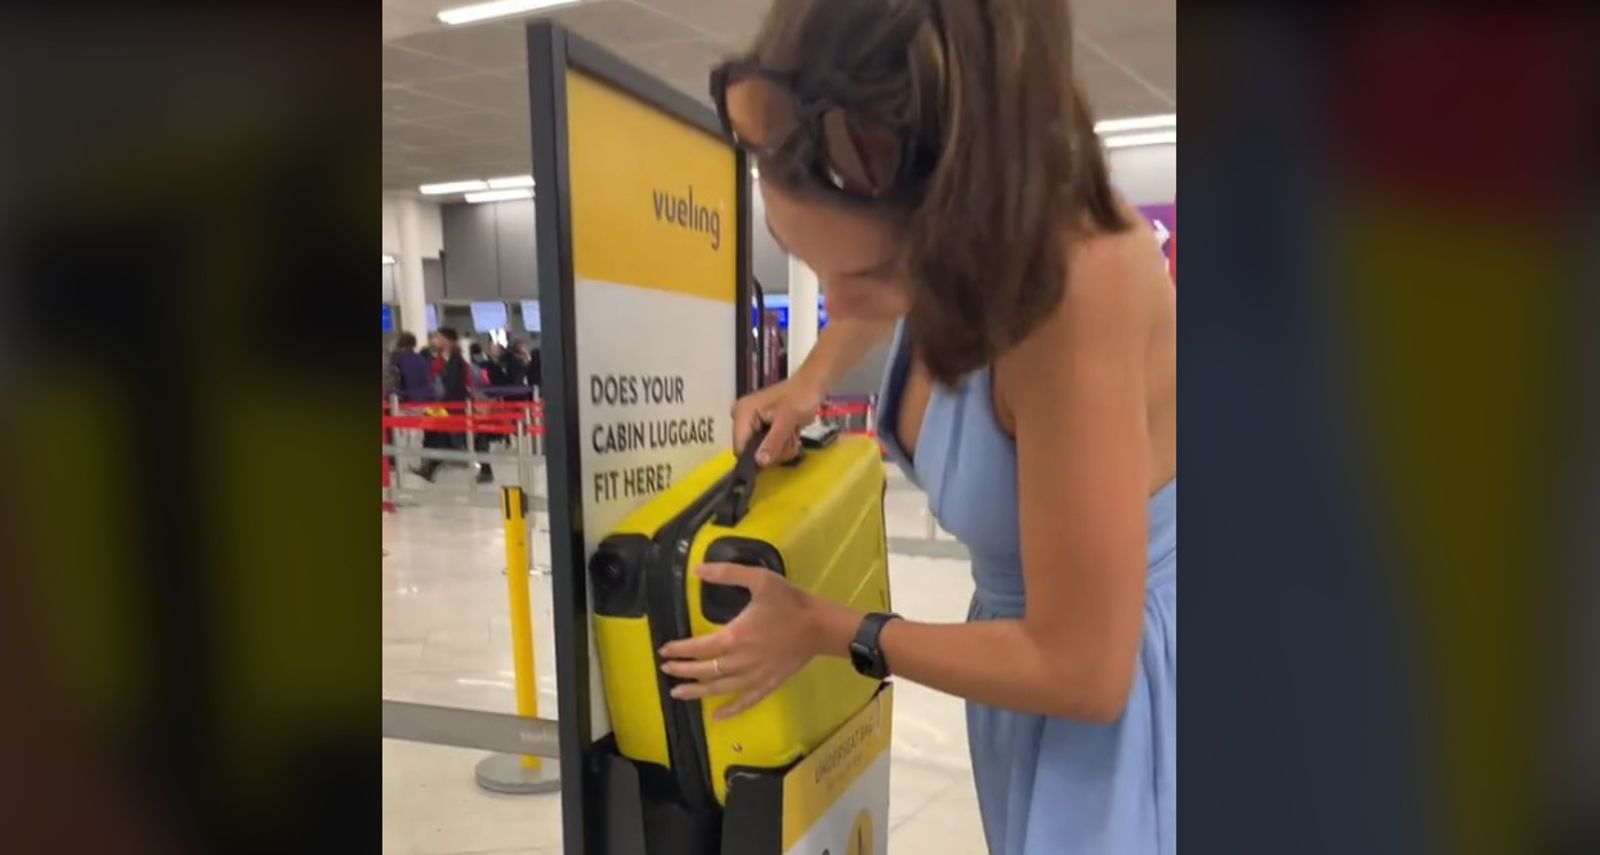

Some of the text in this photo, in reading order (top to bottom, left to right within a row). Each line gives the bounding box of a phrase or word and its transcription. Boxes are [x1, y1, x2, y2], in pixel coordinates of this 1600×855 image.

[653, 186, 721, 250] vueling
[591, 374, 684, 405] DOES YOUR
[592, 417, 715, 455] CABIN LUGGAGE
[594, 464, 672, 502] FIT HERE?
